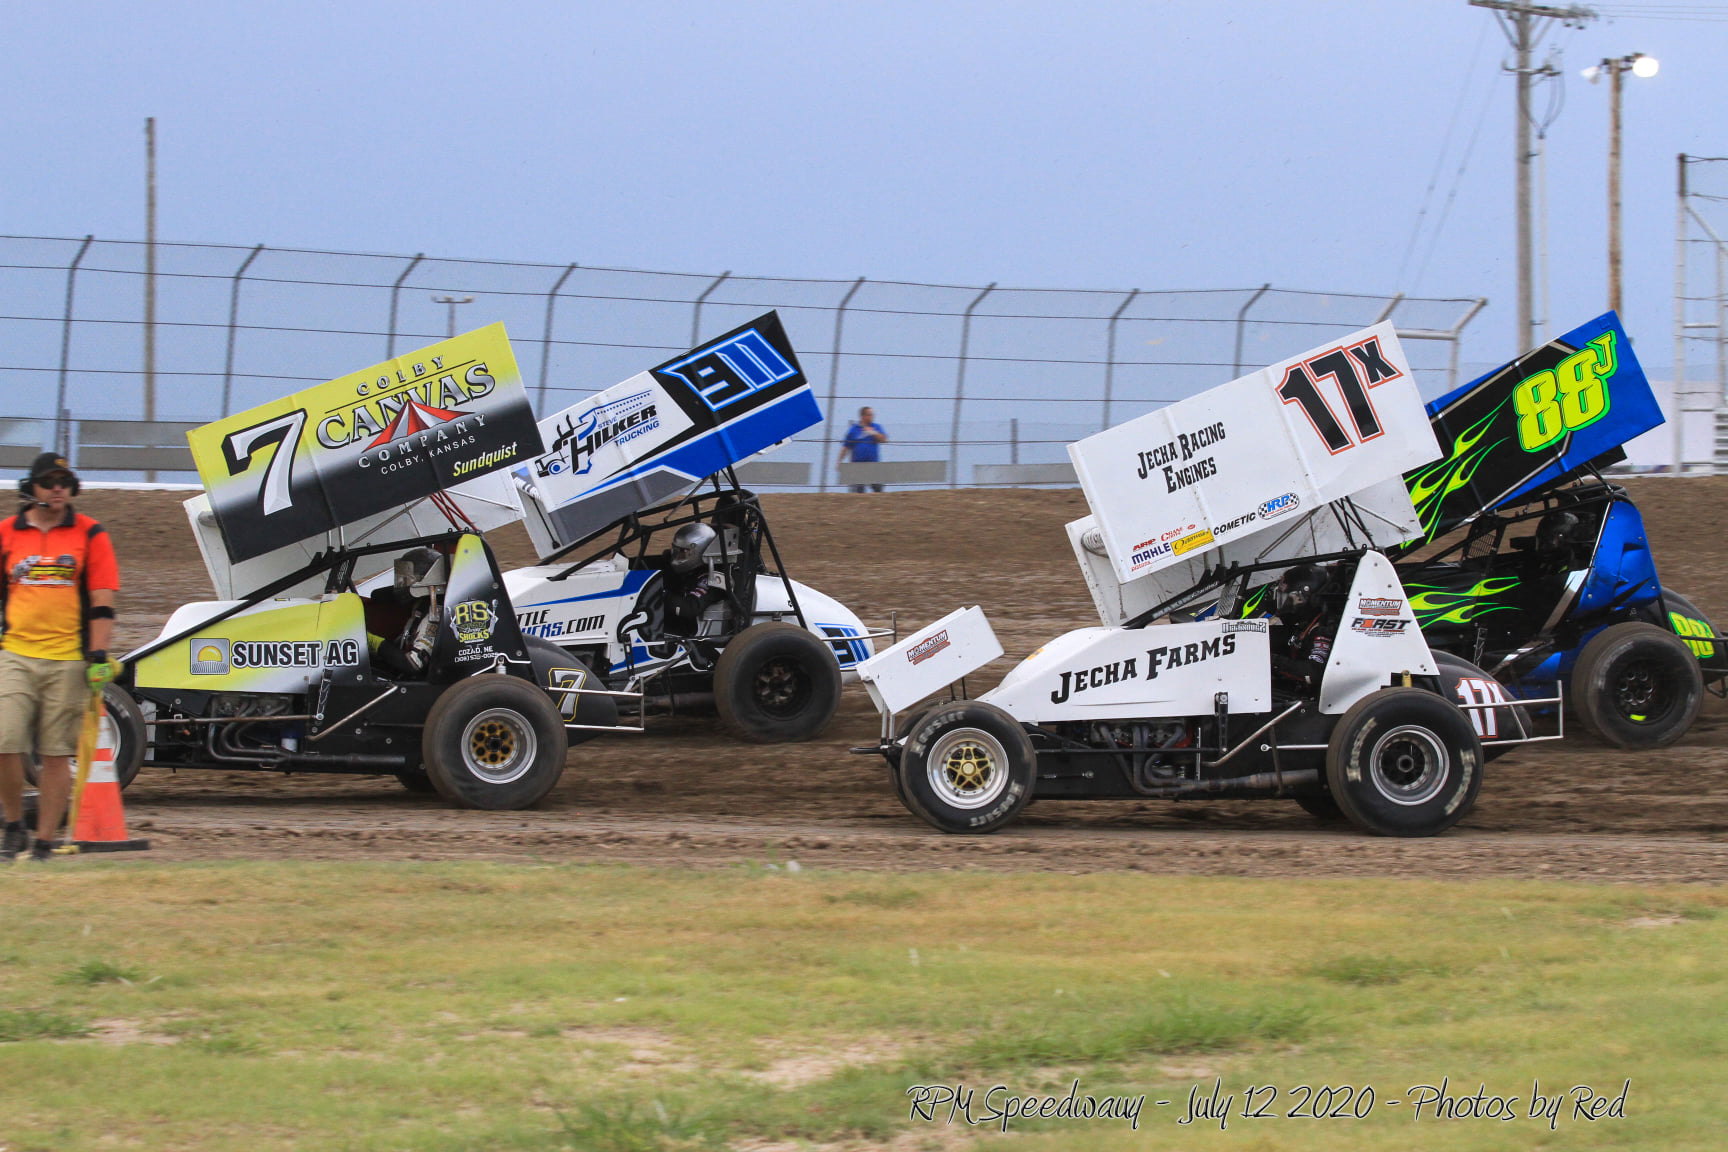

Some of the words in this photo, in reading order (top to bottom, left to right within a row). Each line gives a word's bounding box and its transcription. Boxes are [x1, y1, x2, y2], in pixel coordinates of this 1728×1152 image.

[357, 355, 444, 396] COLBY
[1513, 330, 1617, 452] 88J
[316, 362, 495, 449] CANVAS
[597, 416, 617, 429] STEVE
[358, 414, 487, 468] COMPANY
[569, 404, 657, 475] HILKER
[614, 420, 660, 447] TRUCKING
[1178, 421, 1226, 461] RACING
[221, 408, 308, 516] 7
[380, 455, 424, 475] COLBY,
[429, 435, 476, 458] KANSAS
[452, 441, 518, 477] Sundquist
[1162, 456, 1217, 494] ENGINES
[1267, 494, 1290, 512] HRP
[1213, 512, 1256, 536] COMETIC
[1131, 542, 1171, 565] MAHLE
[1360, 600, 1400, 608] MOMENTUM
[232, 641, 322, 669] SUNSET
[324, 640, 359, 668] AG
[908, 631, 947, 659] MOMENTUM
[1050, 657, 1138, 705] JECHA
[1146, 633, 1237, 681] FARMS
[549, 667, 587, 722] 7
